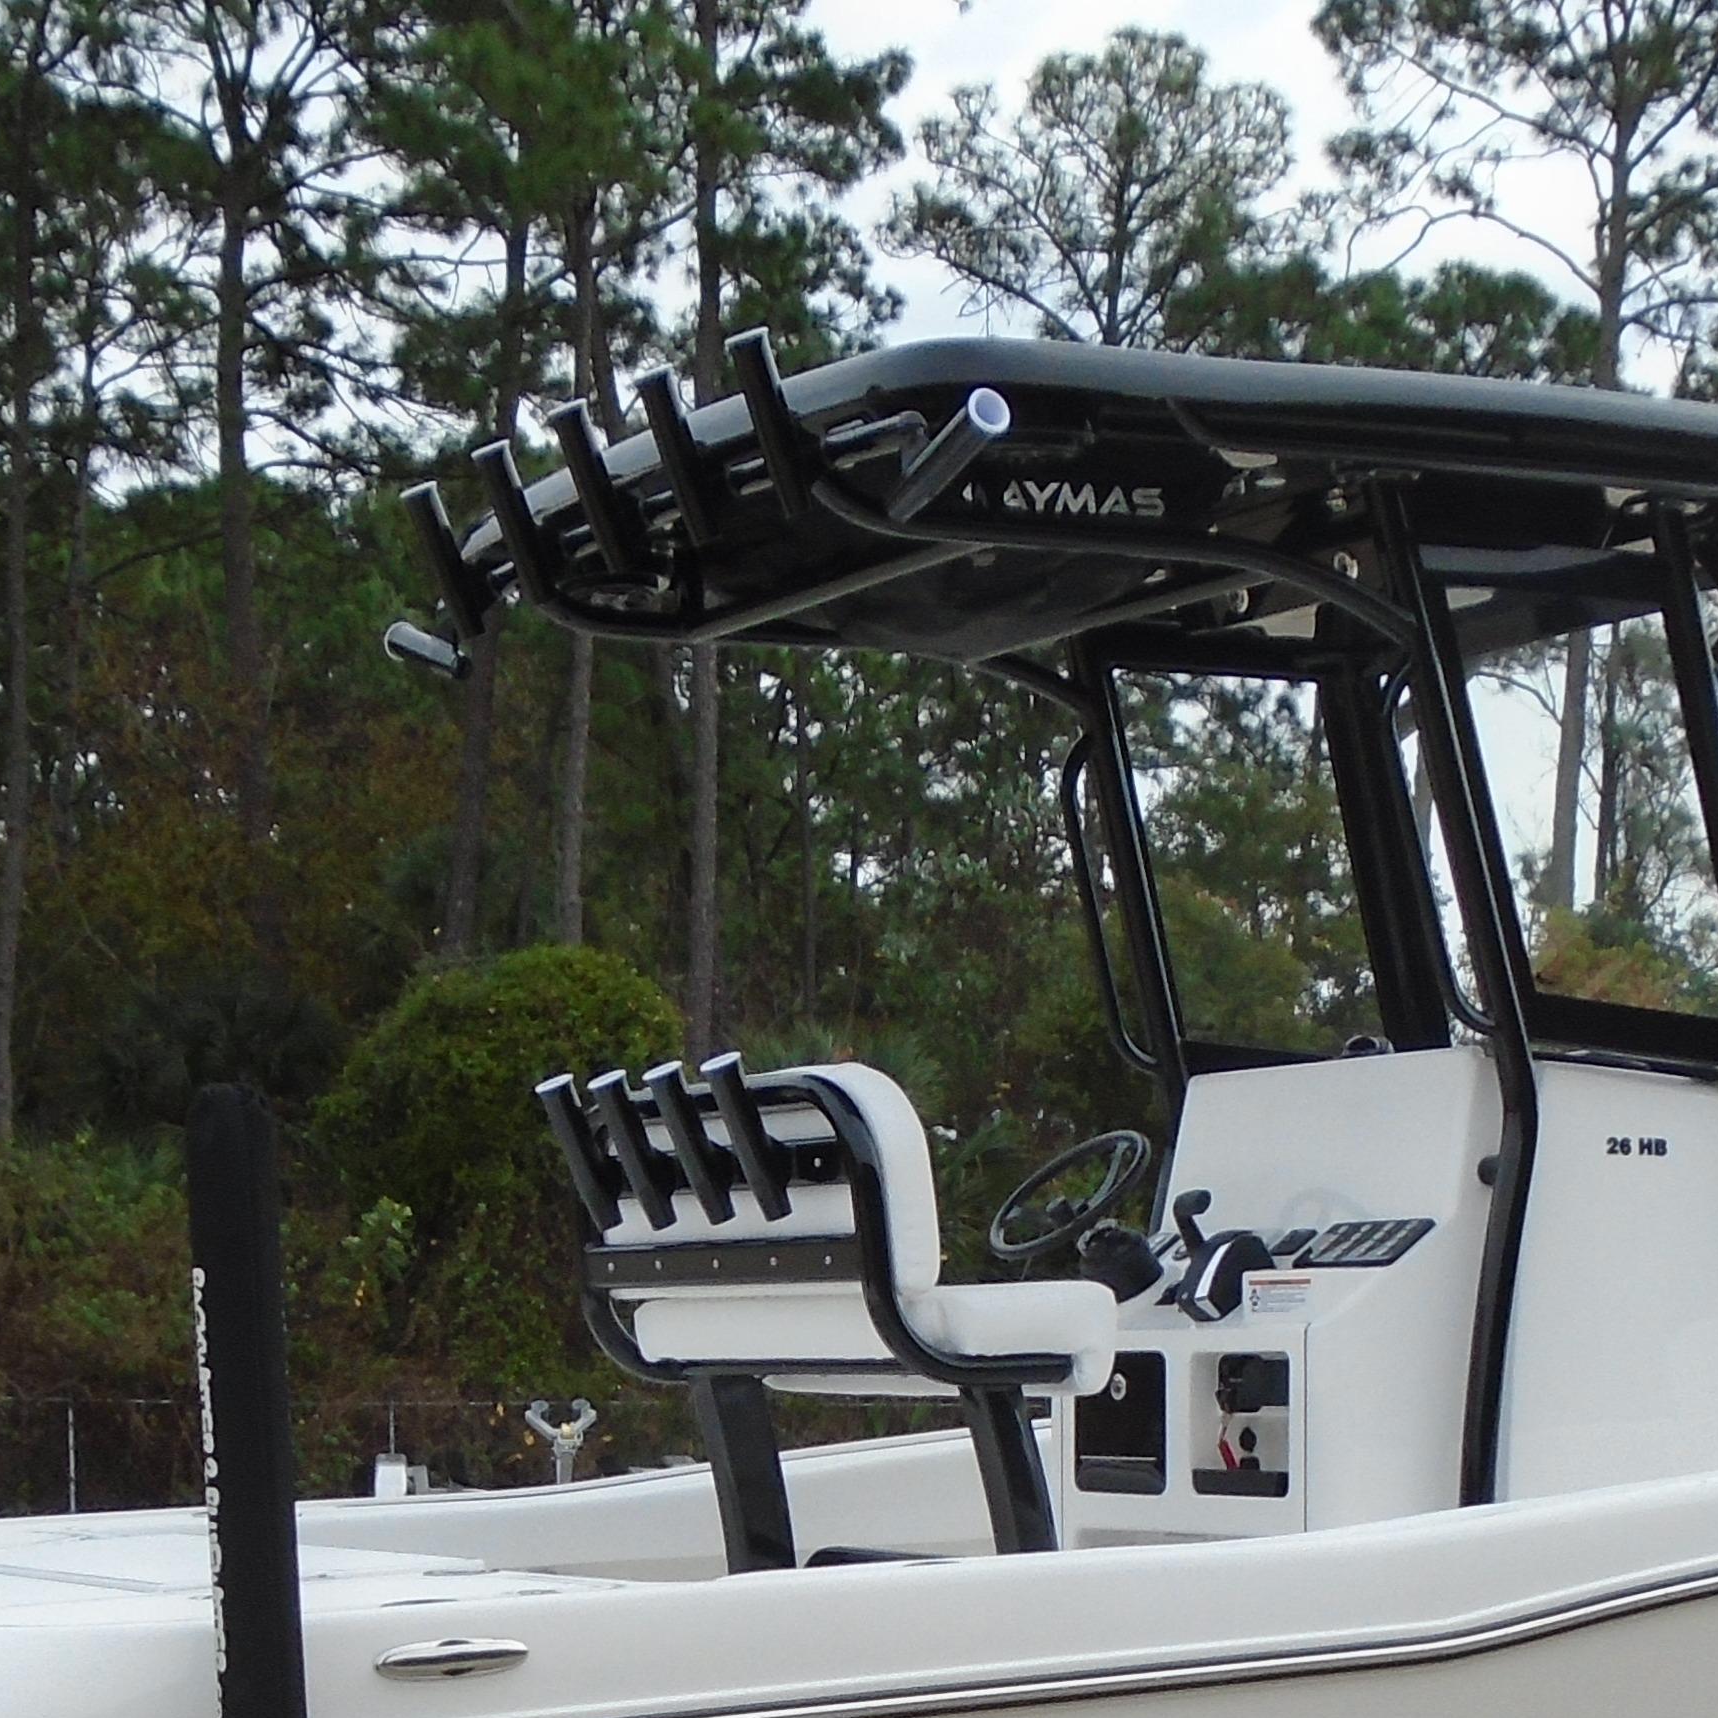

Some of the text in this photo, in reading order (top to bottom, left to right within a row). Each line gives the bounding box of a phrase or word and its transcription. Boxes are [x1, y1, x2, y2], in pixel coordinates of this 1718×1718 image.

[962, 480, 1166, 517] AYMAS
[1606, 1137, 1668, 1157] 26 HB
